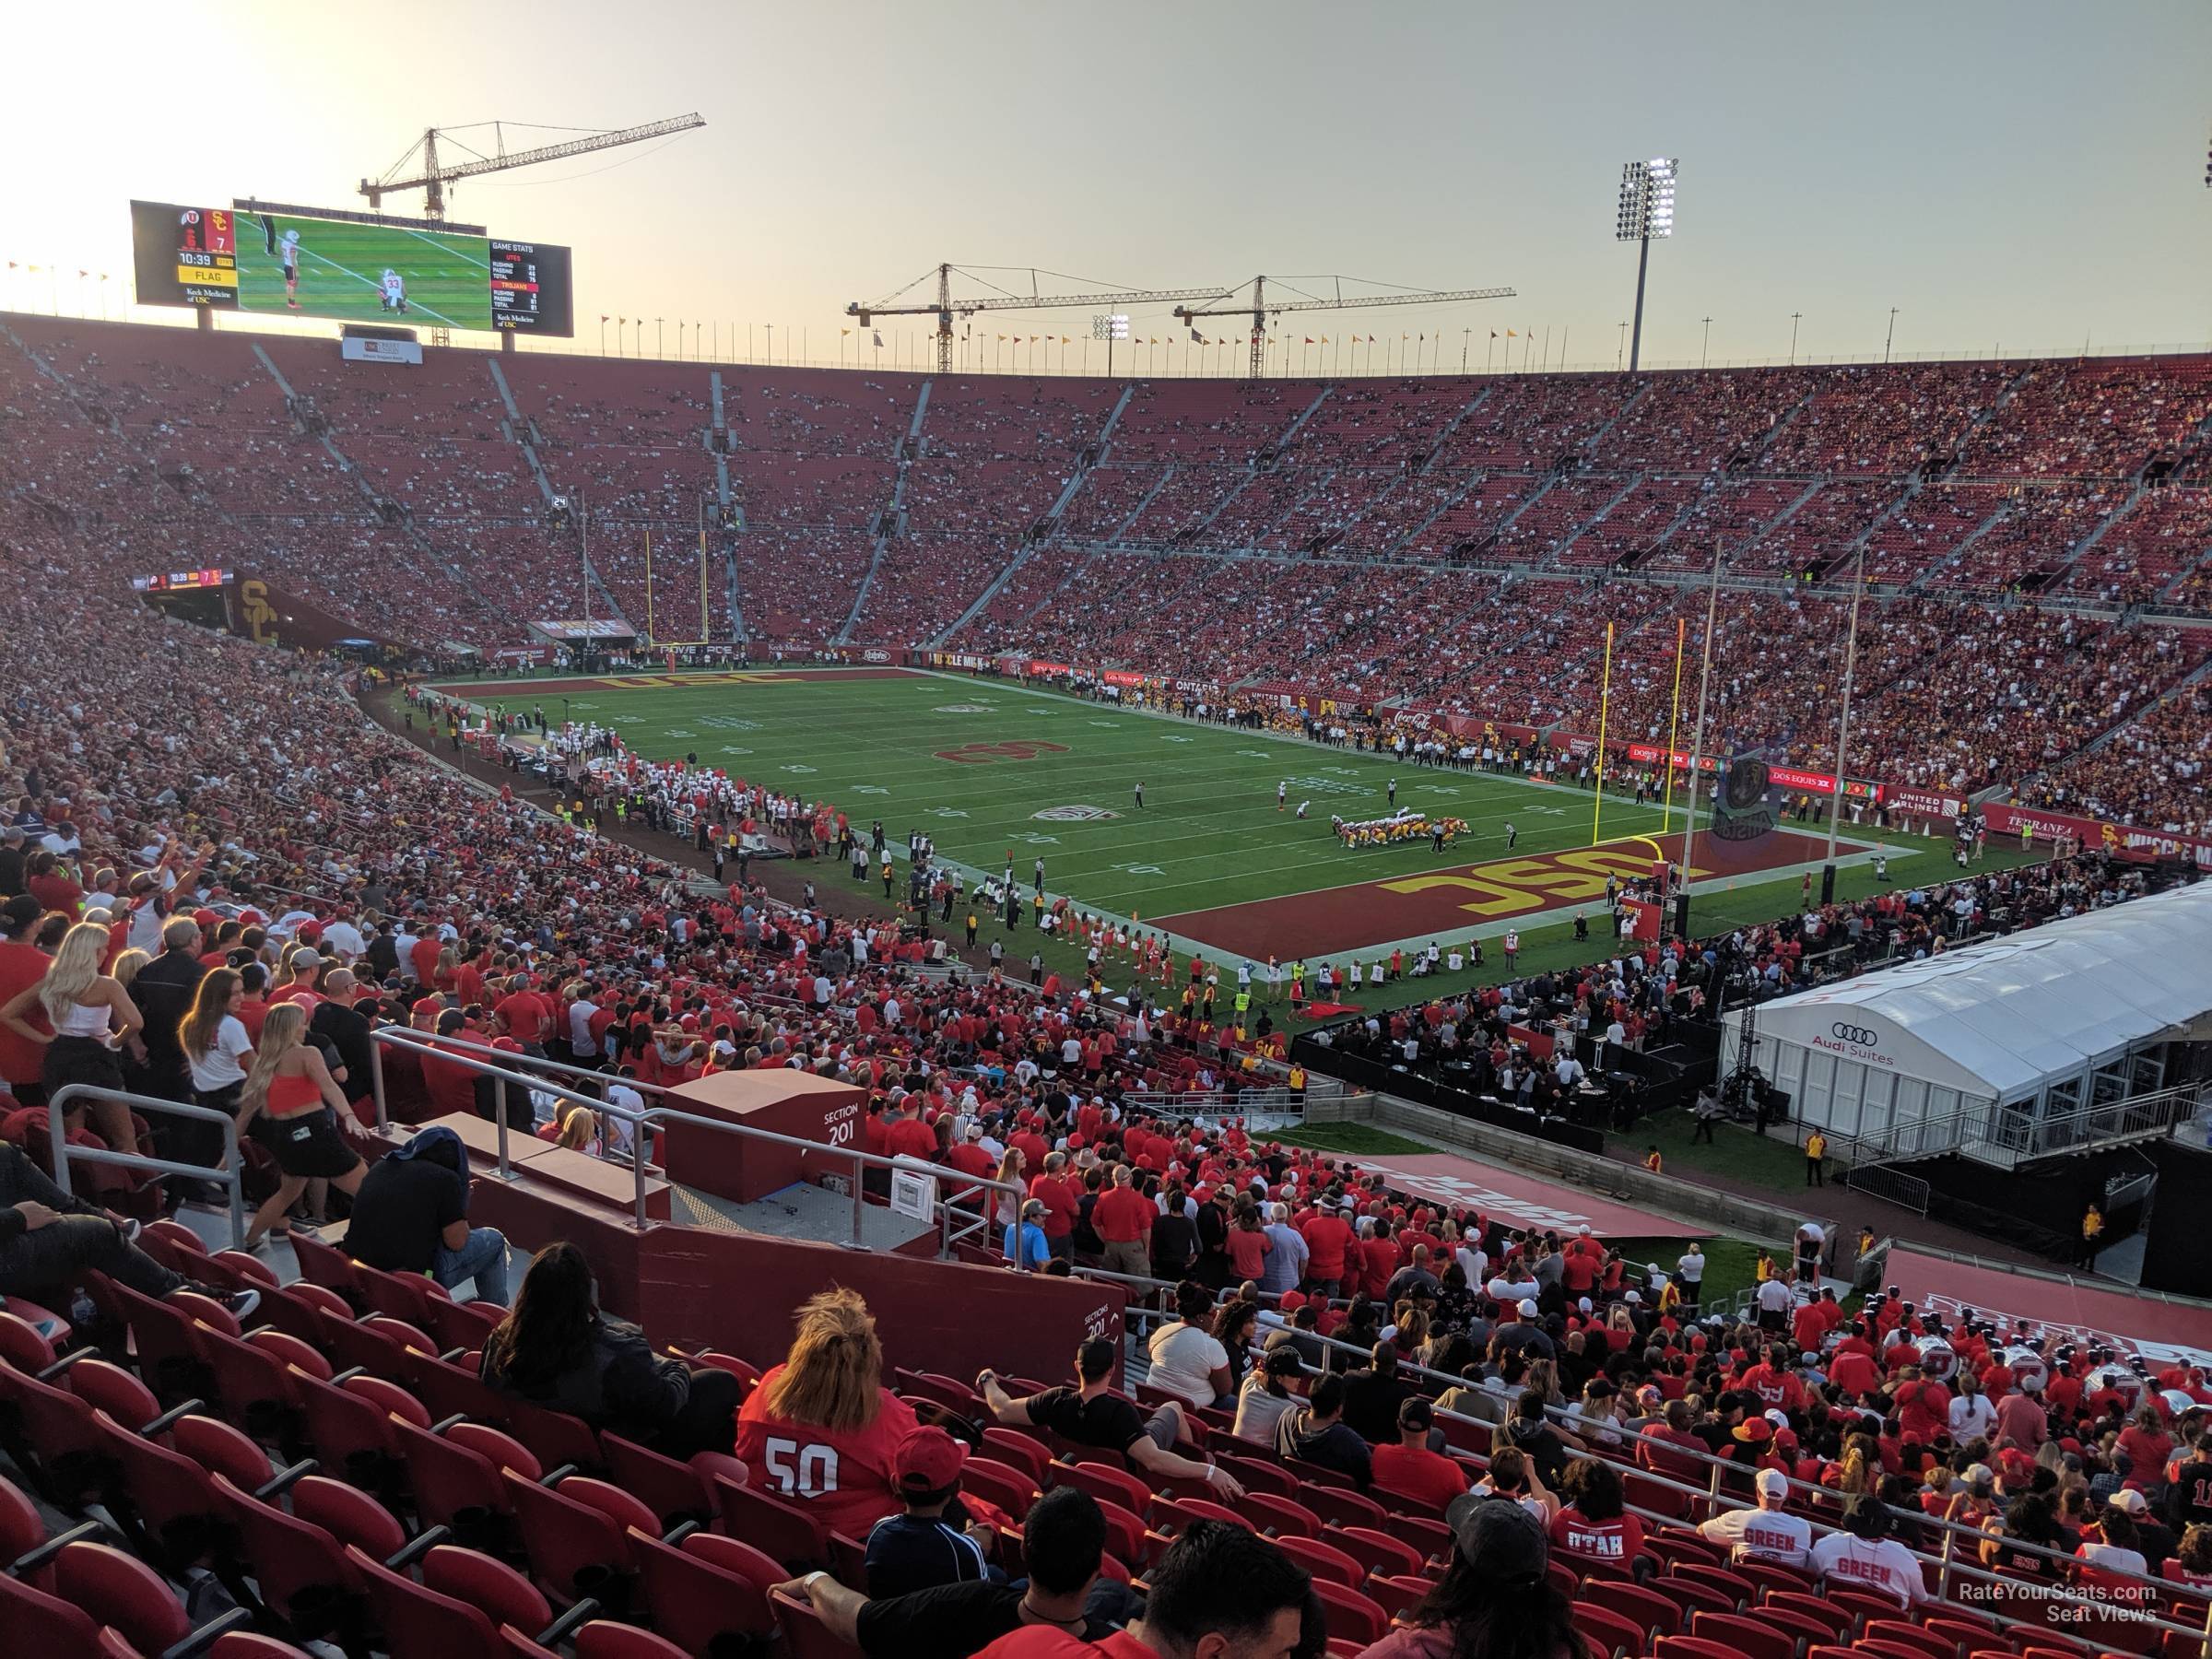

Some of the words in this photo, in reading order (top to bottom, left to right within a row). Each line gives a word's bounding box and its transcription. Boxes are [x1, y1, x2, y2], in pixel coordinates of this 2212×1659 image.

[217, 237, 225, 249] 7
[492, 242, 512, 251] GAME
[512, 244, 534, 253] STATS
[180, 253, 211, 265] 10:39
[195, 271, 221, 281] FLAG
[501, 281, 527, 290] TROJANS
[204, 289, 231, 298] Medicine
[512, 315, 534, 324] Medicine
[539, 620, 626, 630] MUSCLE
[864, 650, 888, 660] Ralphs
[594, 672, 809, 688] USC
[1252, 692, 1278, 700] UNITED
[1773, 771, 1791, 781] DOS
[1792, 775, 1817, 785] EQUIS
[1900, 793, 1940, 806] UNITED
[1006, 830, 1063, 845] 20
[1110, 861, 1168, 877] 10
[1375, 851, 1715, 916] USC
[1812, 1035, 1846, 1053] Audi
[1850, 1044, 1894, 1065] Suites
[824, 1102, 859, 1125] SECTION
[829, 1119, 854, 1147] 201
[1084, 1303, 1109, 1325] SECTIONS
[1088, 1317, 1105, 1336] 201
[765, 1435, 839, 1499] 50
[1568, 1531, 1624, 1557] UTAH
[1744, 1527, 1795, 1552] GREEN
[1838, 1557, 1892, 1583] GREEN
